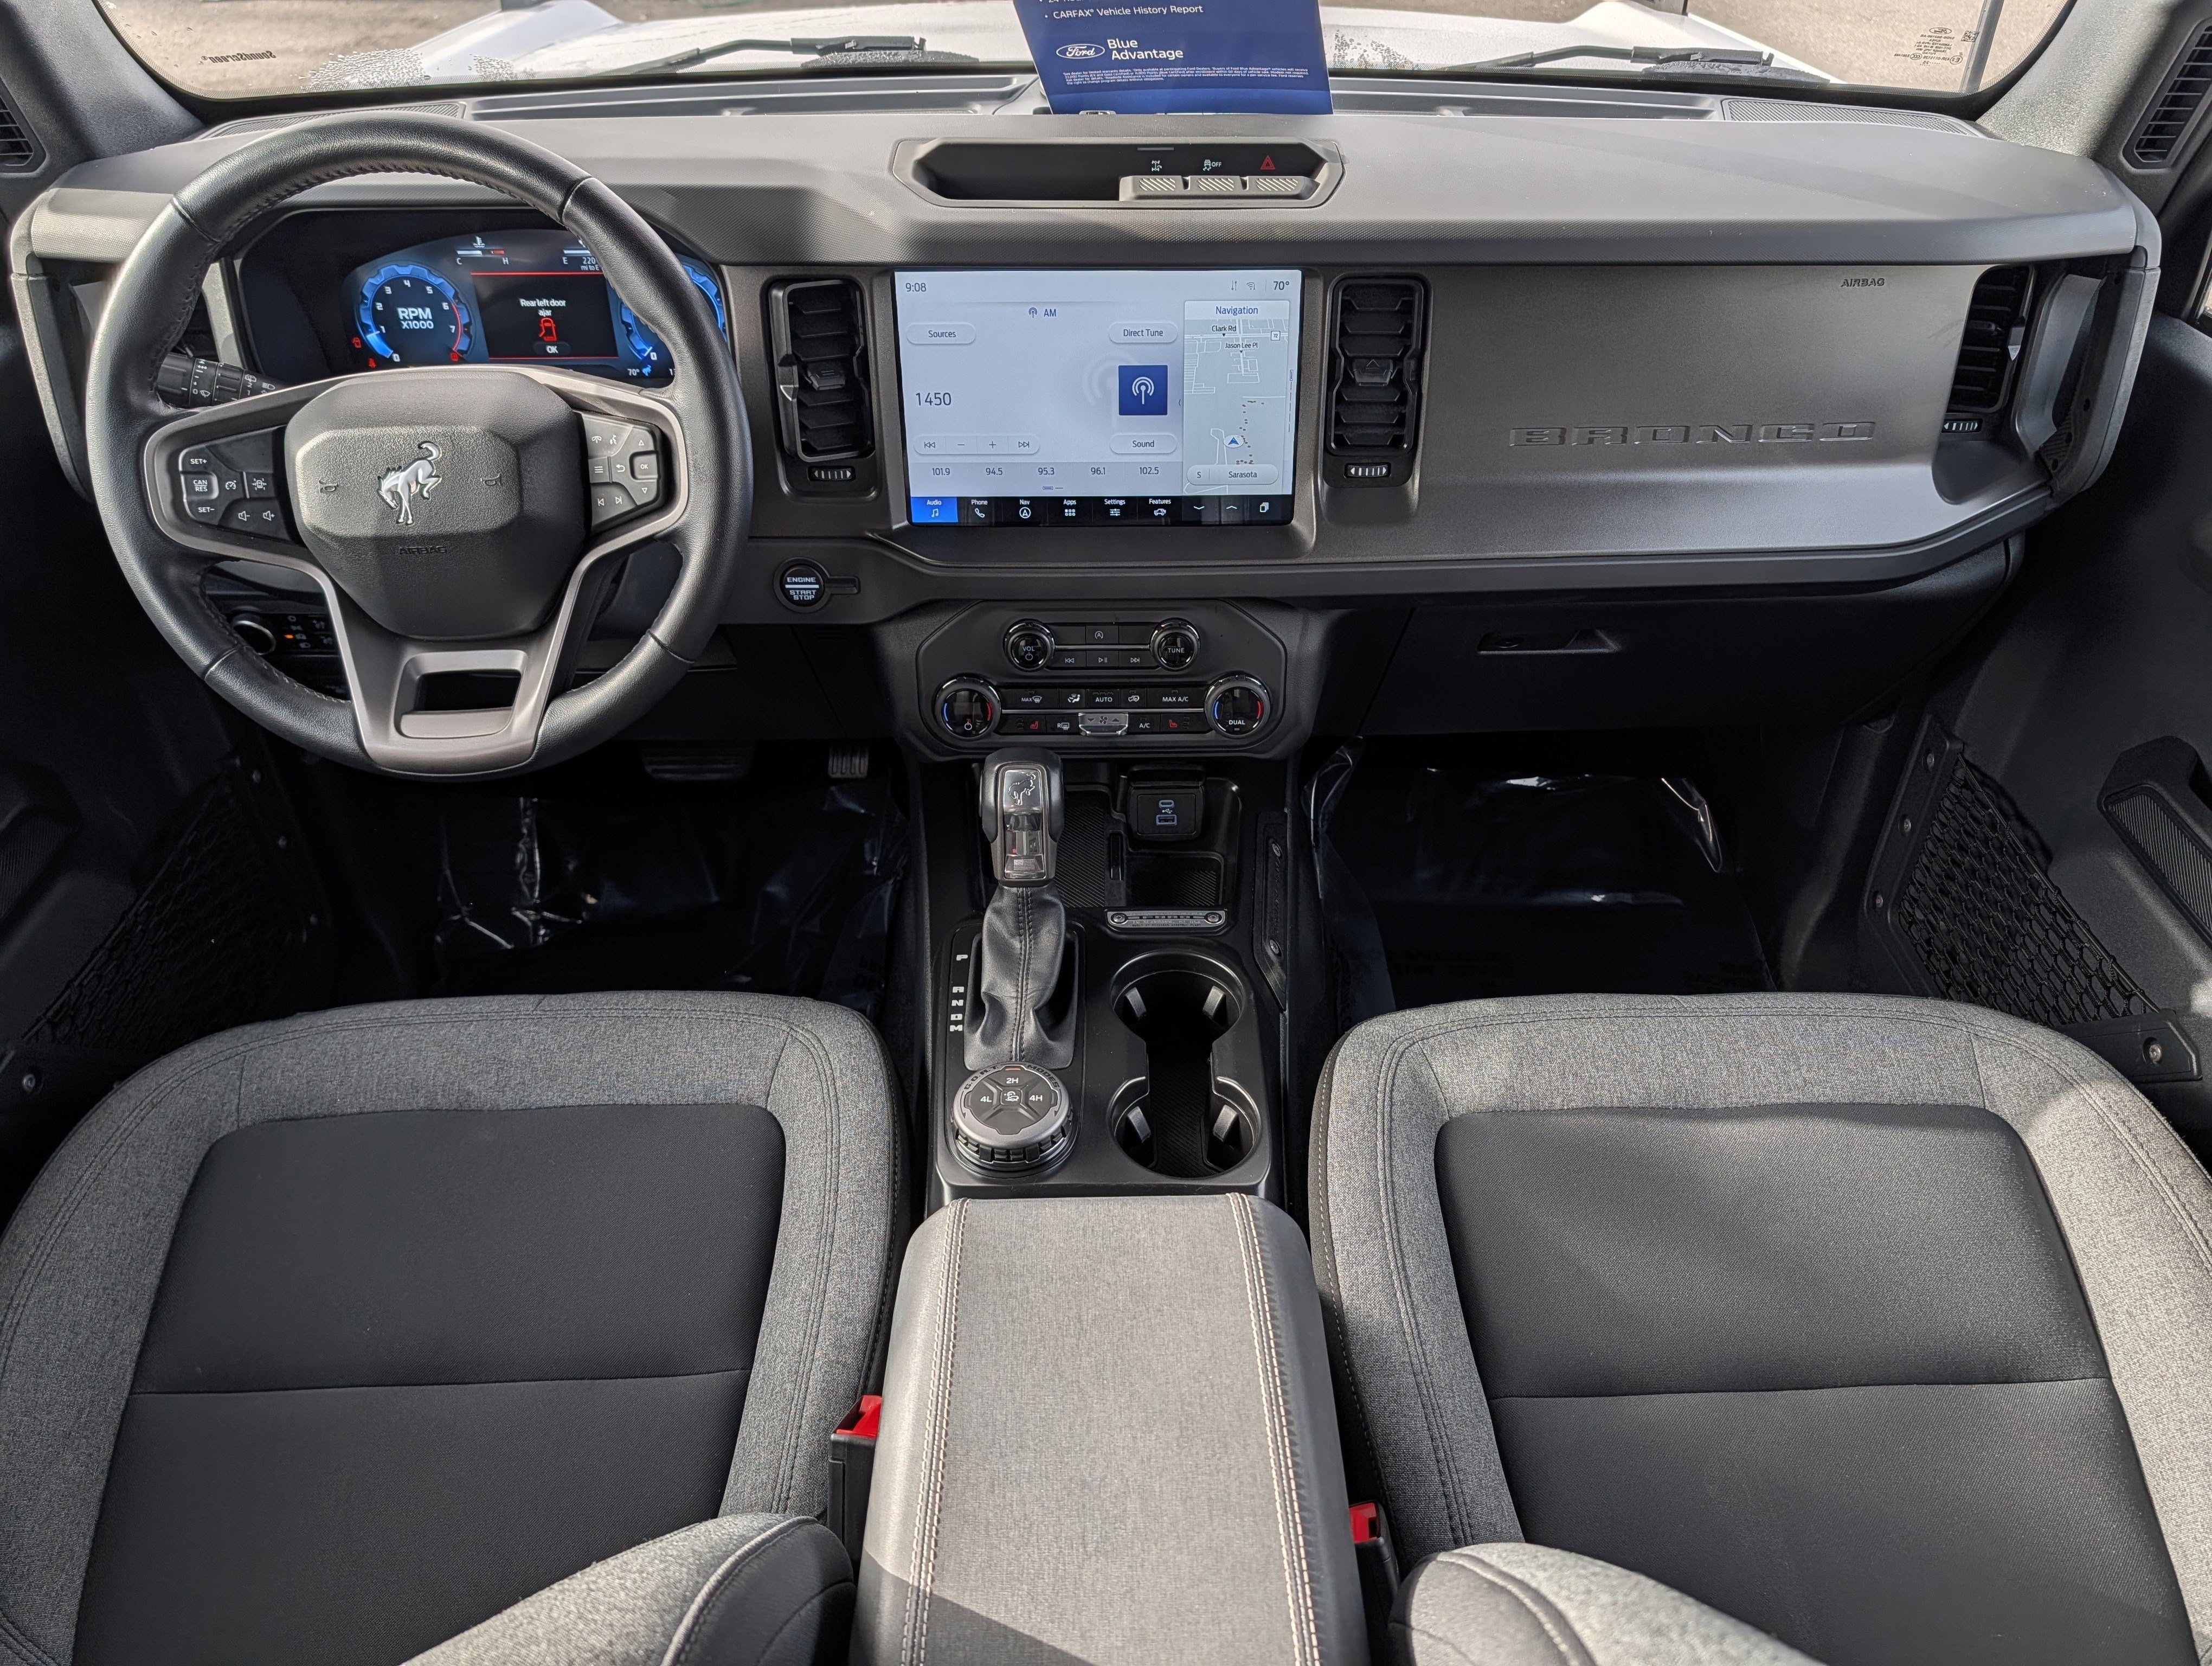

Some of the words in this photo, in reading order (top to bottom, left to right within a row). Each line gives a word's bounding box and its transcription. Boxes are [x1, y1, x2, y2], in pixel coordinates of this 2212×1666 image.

[1097, 8, 1131, 16] Vehicle
[1134, 7, 1166, 15] History
[1171, 5, 1203, 15] Report
[1107, 39, 1138, 49] Blue
[1066, 46, 1096, 57] Ford
[1111, 49, 1184, 60] Advantage
[456, 257, 462, 265] C
[403, 280, 411, 288] 4
[1272, 281, 1290, 291] 70°
[1840, 278, 1885, 287] AIRBAG
[384, 286, 392, 294] 3
[426, 286, 433, 294] 5
[905, 283, 927, 292] 9:08
[375, 302, 383, 310] 2
[441, 302, 449, 310] 6
[519, 298, 537, 307] Rear
[537, 298, 550, 307] left
[550, 298, 566, 307] door
[397, 307, 433, 319] RPM
[538, 309, 552, 317] ajar
[1044, 309, 1057, 317] AM
[1216, 306, 1258, 316] Navigation
[379, 325, 385, 334] 1
[449, 325, 455, 333] 7
[1123, 329, 1143, 337] Direct
[1145, 329, 1163, 337] Tune
[928, 330, 956, 338] Sources
[546, 345, 558, 354] OK
[392, 354, 400, 362] 0
[650, 352, 658, 361] 0
[915, 392, 952, 406] 1450
[1510, 421, 1876, 447] BRONCO
[931, 467, 950, 476] 101.9
[986, 467, 1003, 476] 94.5
[1038, 467, 1054, 476] 95.3
[1091, 467, 1106, 475] 96.1
[1139, 467, 1159, 475] 102.5
[1027, 1064, 1060, 1088] MODES
